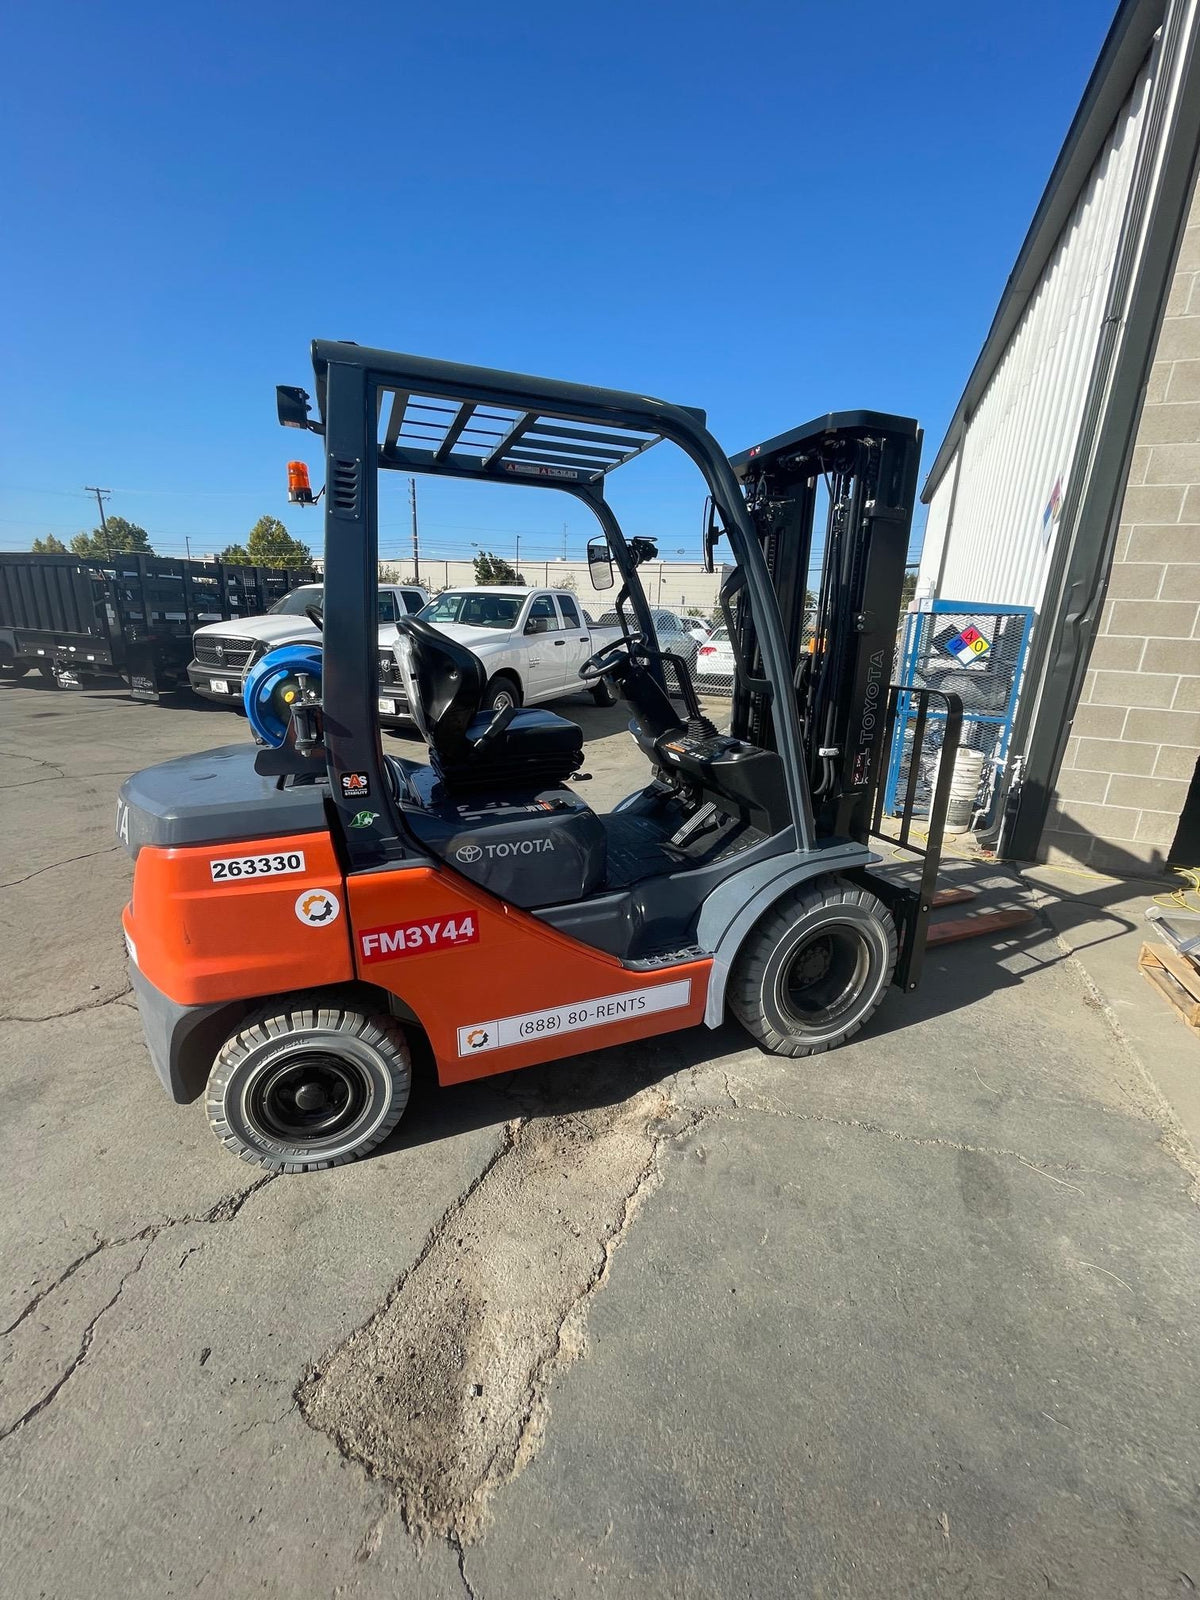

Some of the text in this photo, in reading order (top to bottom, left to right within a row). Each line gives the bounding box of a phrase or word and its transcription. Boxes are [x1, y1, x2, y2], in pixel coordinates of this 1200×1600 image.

[953, 639, 983, 652] 2 0
[965, 631, 974, 642] 4
[859, 649, 884, 745] TOYOTA
[342, 774, 368, 789] SAS
[485, 838, 555, 858] TOYOTA
[212, 854, 301, 879] 263330
[362, 917, 475, 957] FM3Y44
[519, 996, 646, 1037] (888) 80-RENTS
